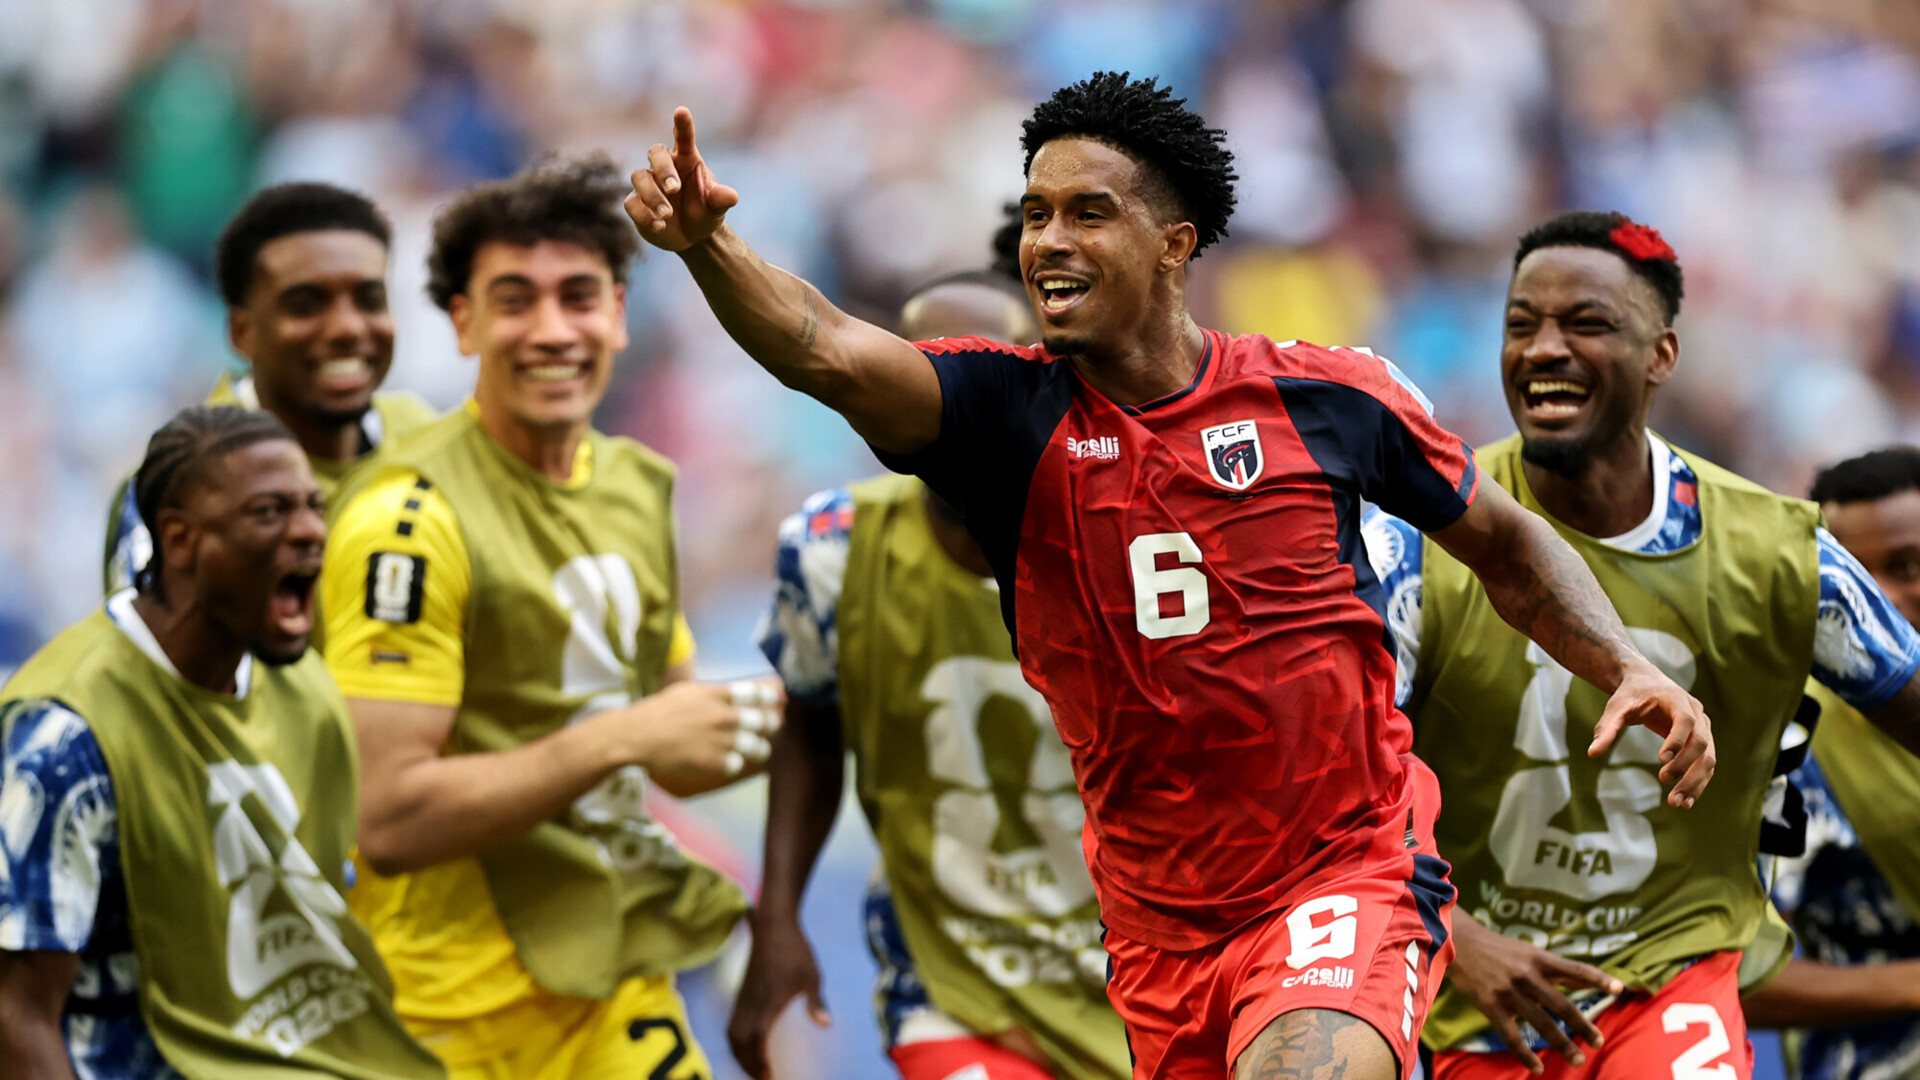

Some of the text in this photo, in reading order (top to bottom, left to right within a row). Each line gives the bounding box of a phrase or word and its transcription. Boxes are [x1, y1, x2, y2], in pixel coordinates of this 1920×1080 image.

[1067, 436, 1120, 458] apelli
[1207, 423, 1251, 442] FCF
[1128, 532, 1211, 640] 6
[1535, 840, 1614, 876] FIFA
[1285, 894, 1358, 970] 6
[1480, 879, 1584, 931] WORLD
[627, 1016, 703, 1080] 2
[1661, 1002, 1740, 1080] 2
